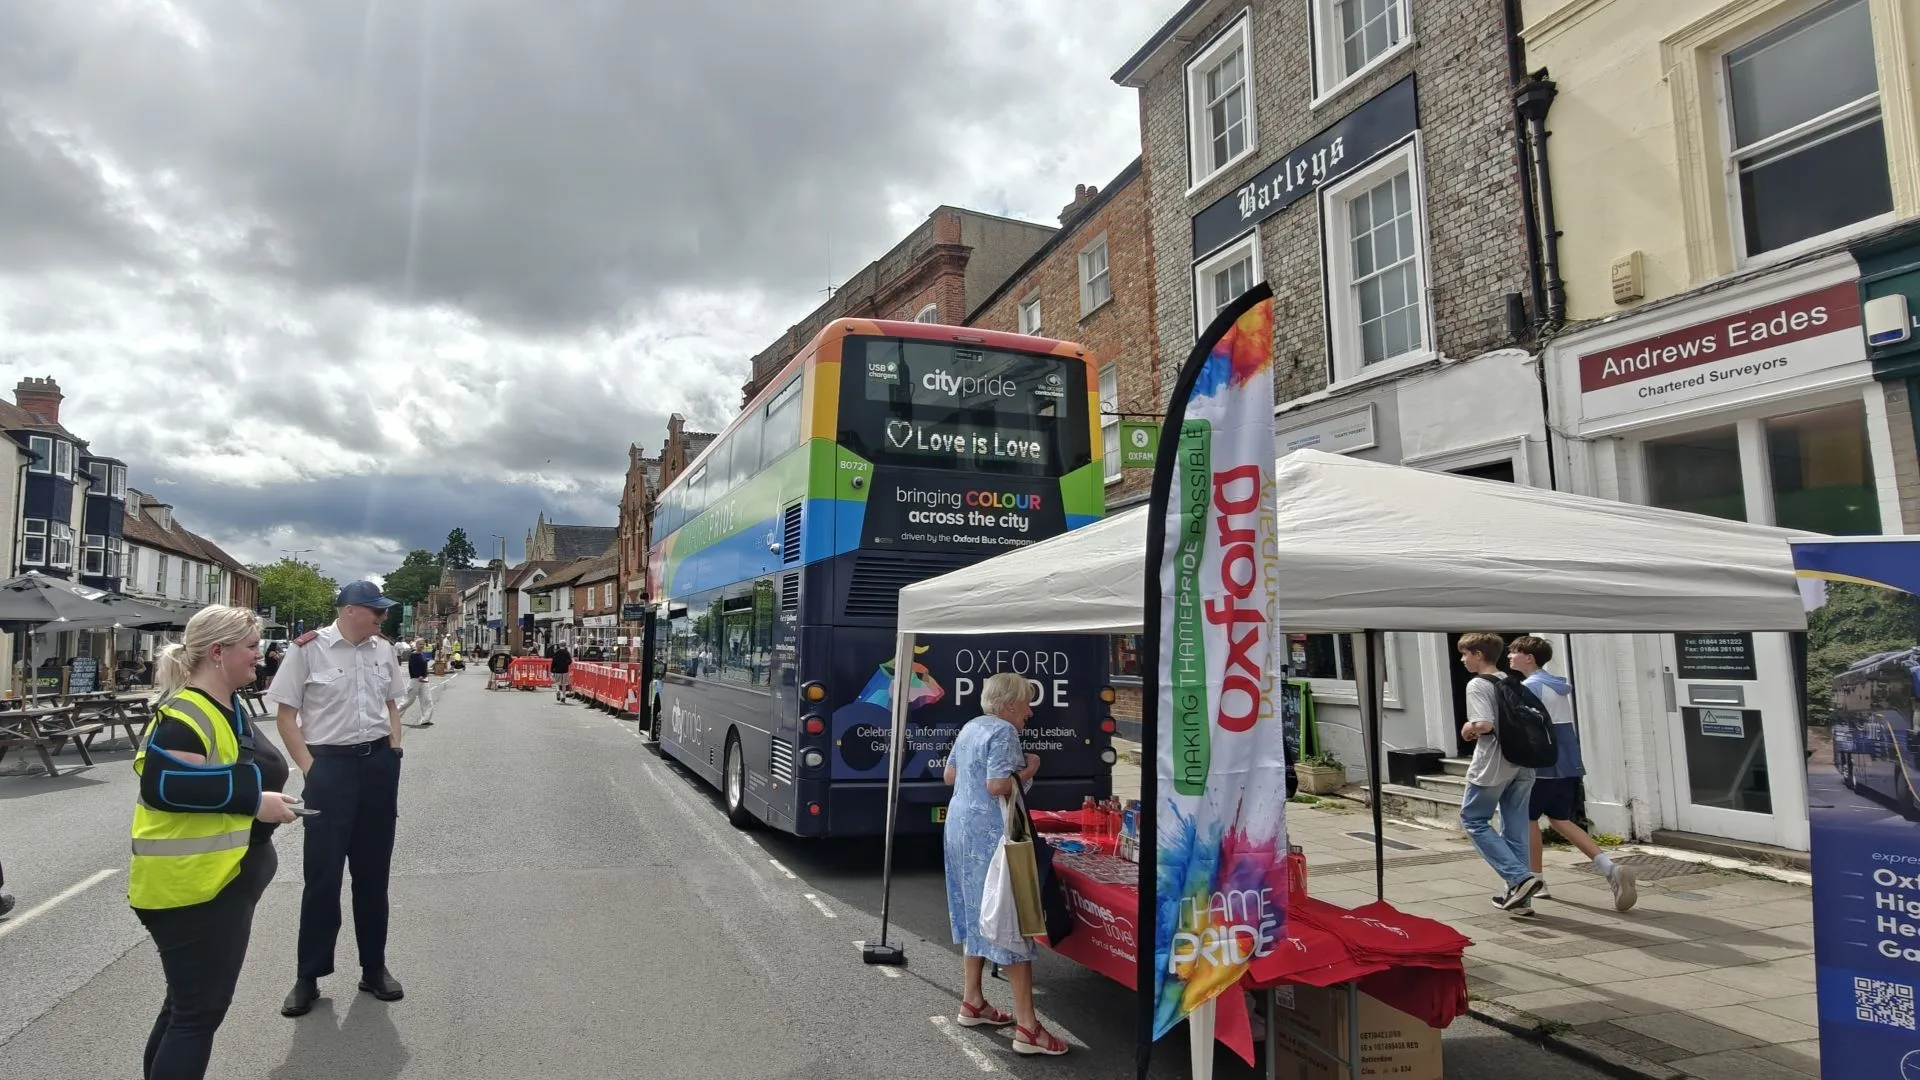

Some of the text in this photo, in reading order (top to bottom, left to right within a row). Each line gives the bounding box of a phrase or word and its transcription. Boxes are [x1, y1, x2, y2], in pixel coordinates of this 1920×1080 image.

[1237, 135, 1344, 222] Barleys
[1602, 306, 1829, 380] Andrews Eades
[868, 362, 886, 372] USB
[868, 371, 898, 380] chargers
[1638, 356, 1788, 398] Chartered Surveyors
[917, 426, 1041, 459] Love is Love
[1128, 451, 1154, 461] OXFAM
[839, 460, 868, 471] 80721
[896, 486, 1042, 510] bringing COLOUR
[908, 510, 1029, 532] across the city
[901, 532, 925, 541] driven
[927, 533, 937, 544] by
[938, 534, 951, 542] the
[952, 535, 980, 544] Oxford
[981, 536, 997, 544] Bus
[1179, 429, 1206, 787] MAKING THAMEPRIDE POSSIBLE
[1204, 465, 1267, 733] oxford
[955, 648, 1069, 675] OXFORD
[955, 677, 1069, 707] PDE
[856, 726, 914, 739] Celebrag,
[1040, 727, 1077, 738] Lesbian,
[907, 740, 933, 751] Trans
[1020, 740, 1063, 751] xfordshire
[1070, 888, 1115, 923] Thames
[1179, 888, 1275, 929] THAME
[1102, 919, 1137, 948] travel
[1877, 915, 1920, 938] He
[1169, 920, 1277, 974] PRIDE
